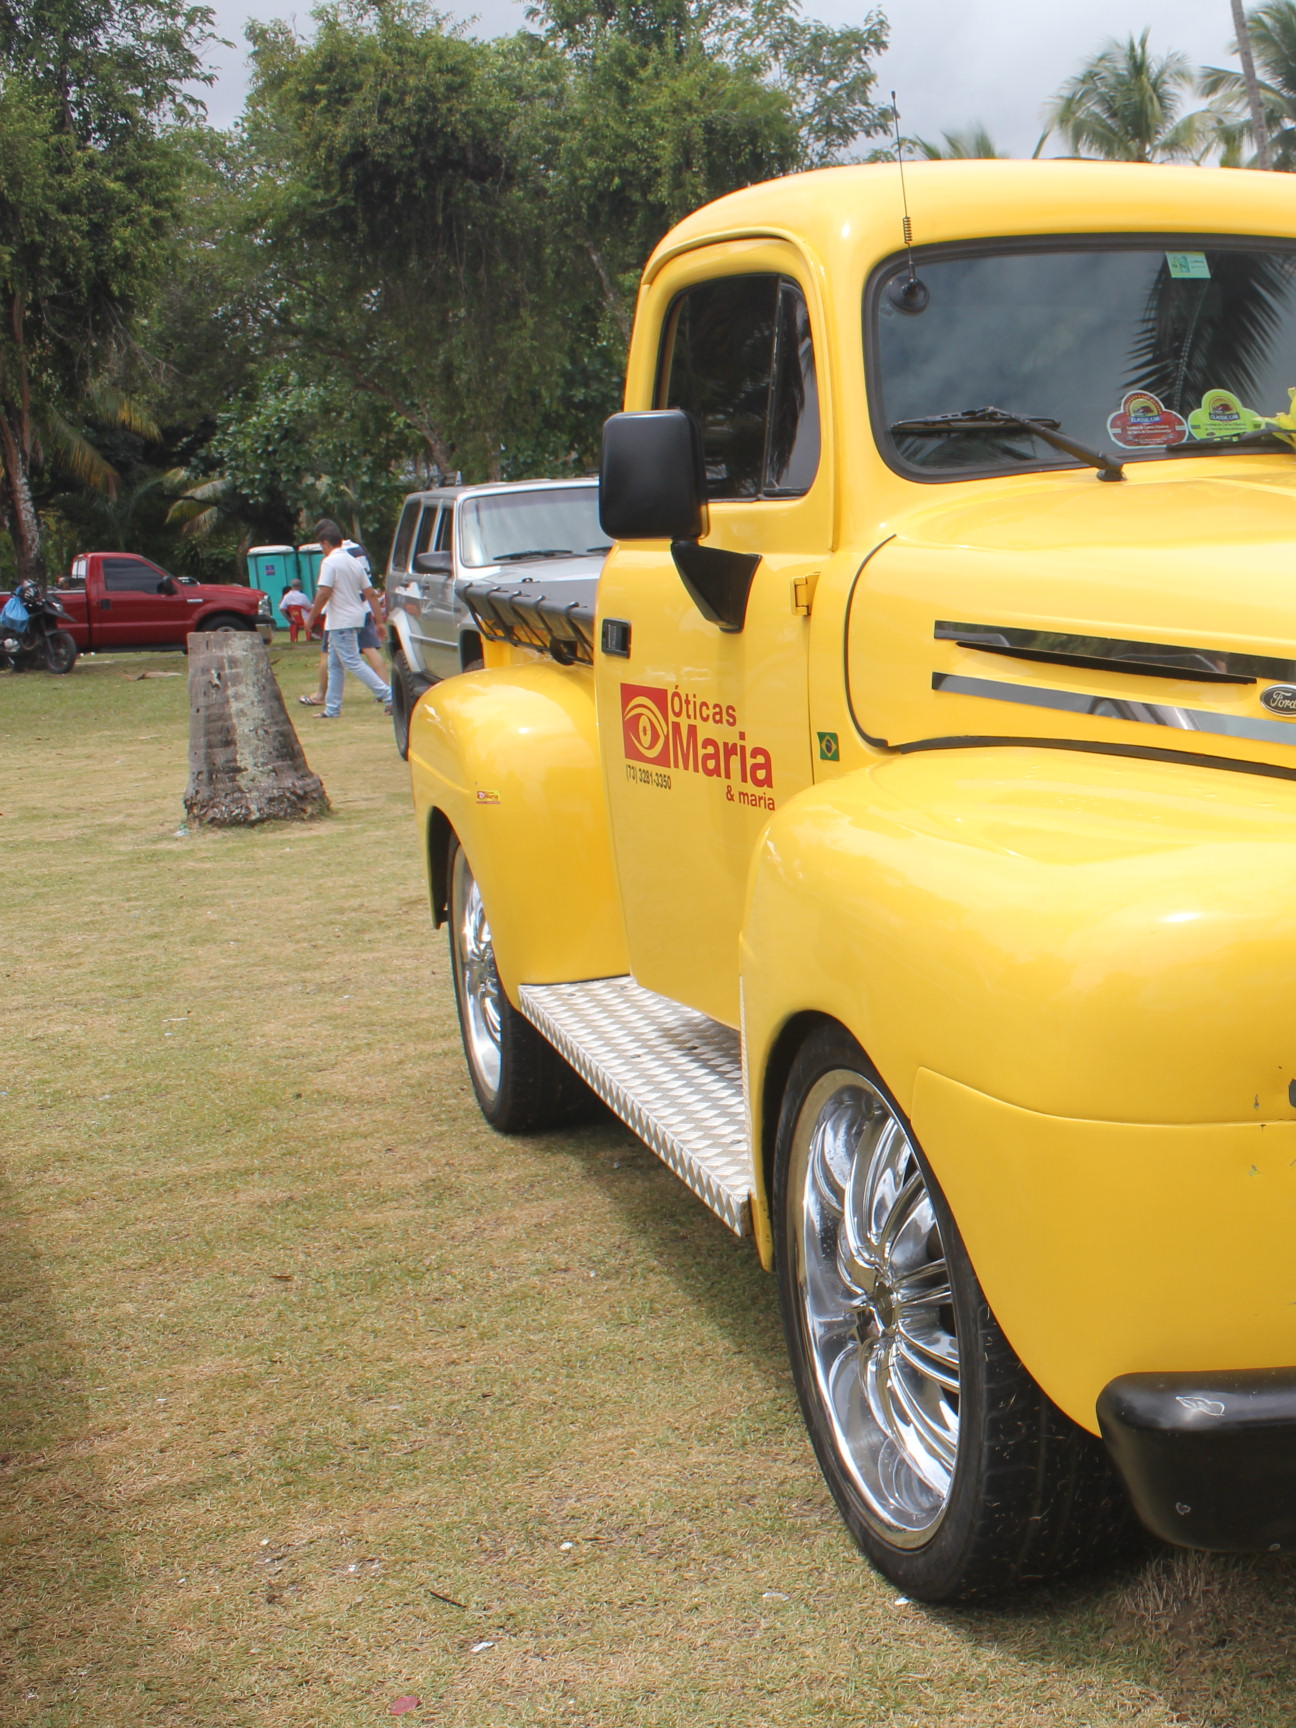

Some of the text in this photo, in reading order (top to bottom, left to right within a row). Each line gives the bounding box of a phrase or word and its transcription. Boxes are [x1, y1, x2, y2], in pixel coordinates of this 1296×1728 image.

[670, 685, 737, 727] Óticas
[671, 720, 774, 789] Maria
[625, 764, 638, 784] (73)
[725, 785, 776, 811] & maria
